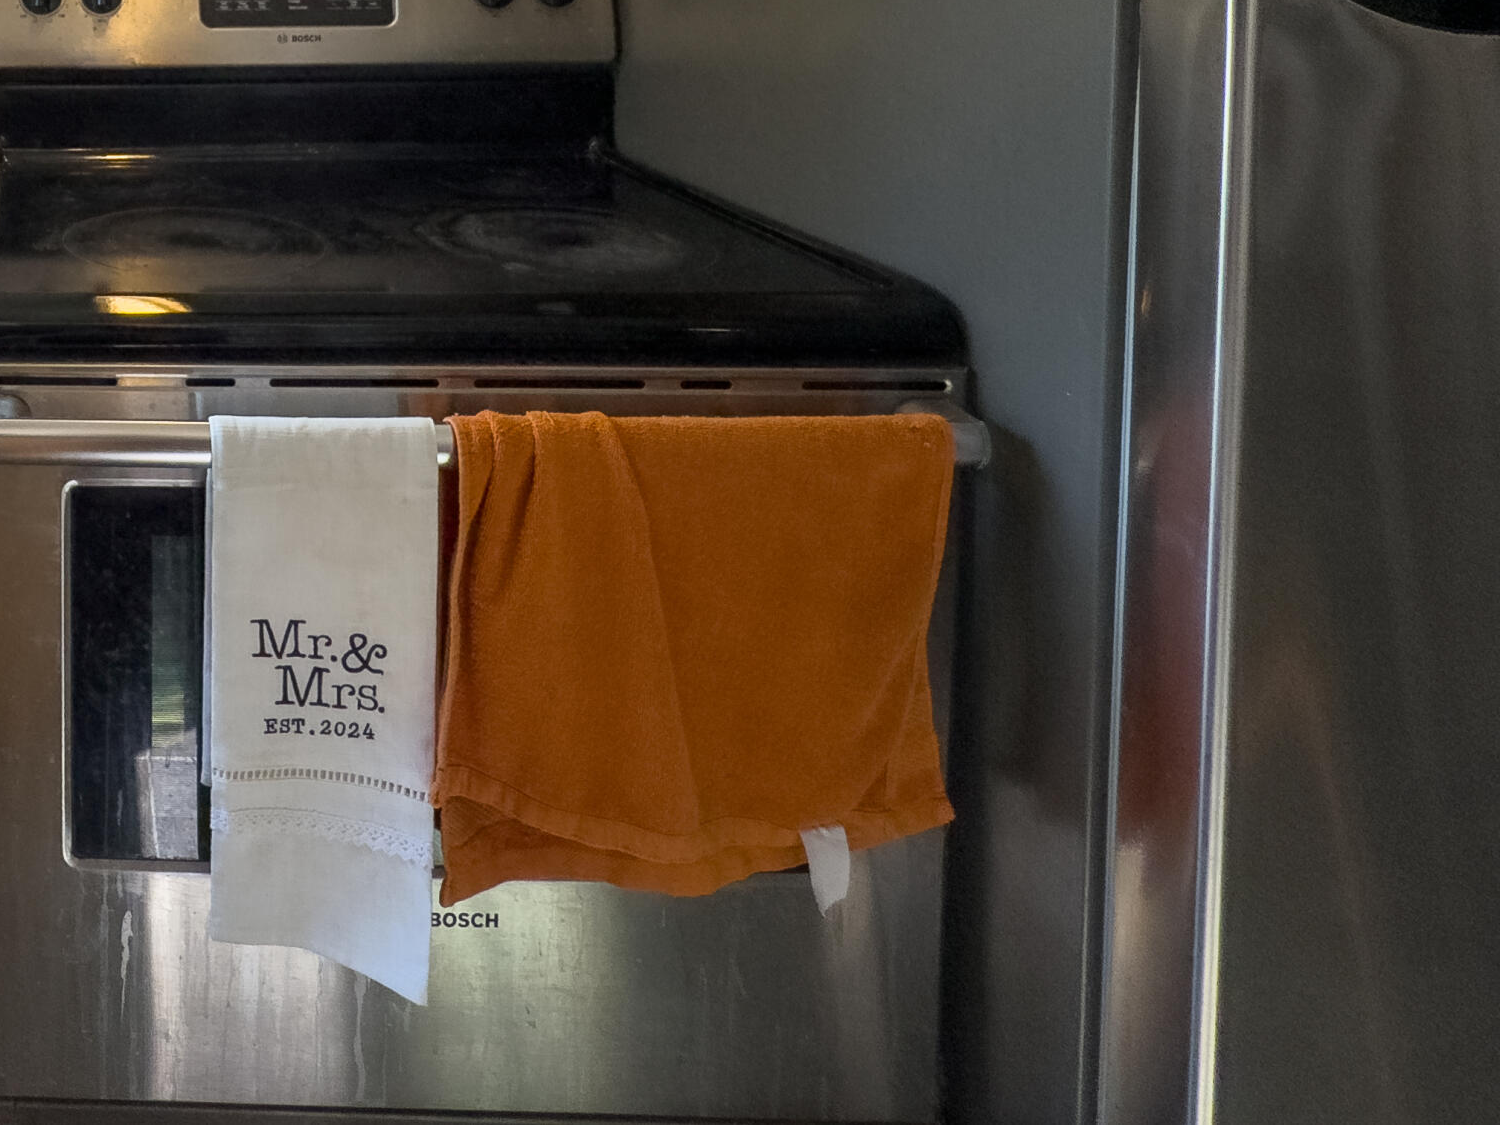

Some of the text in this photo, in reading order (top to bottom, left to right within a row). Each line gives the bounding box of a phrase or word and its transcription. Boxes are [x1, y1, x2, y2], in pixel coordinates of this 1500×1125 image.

[292, 35, 322, 43] BOSCH
[275, 665, 386, 713] Mrs.
[431, 912, 499, 928] BOSCH
